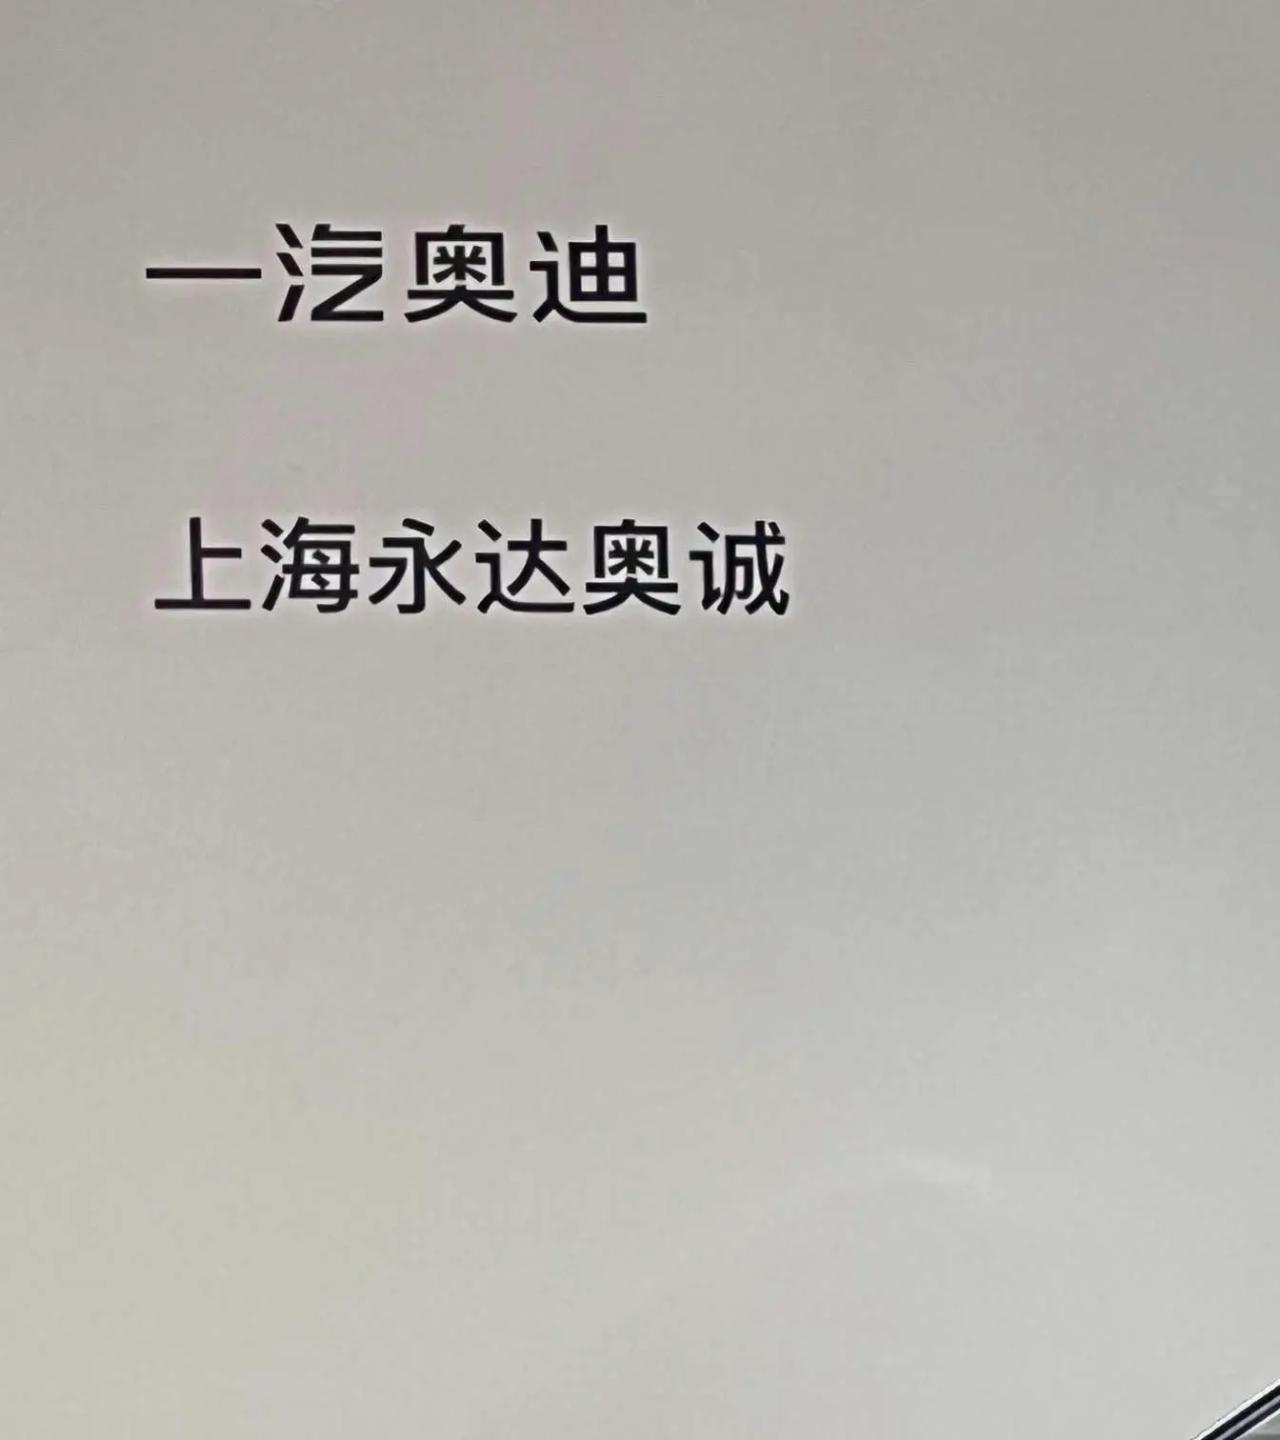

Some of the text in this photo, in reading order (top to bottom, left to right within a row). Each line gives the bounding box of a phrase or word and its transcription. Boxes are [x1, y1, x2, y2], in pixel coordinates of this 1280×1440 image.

[146, 223, 647, 323] 一汽奥迪
[154, 516, 789, 615] 上海永达奥诚
